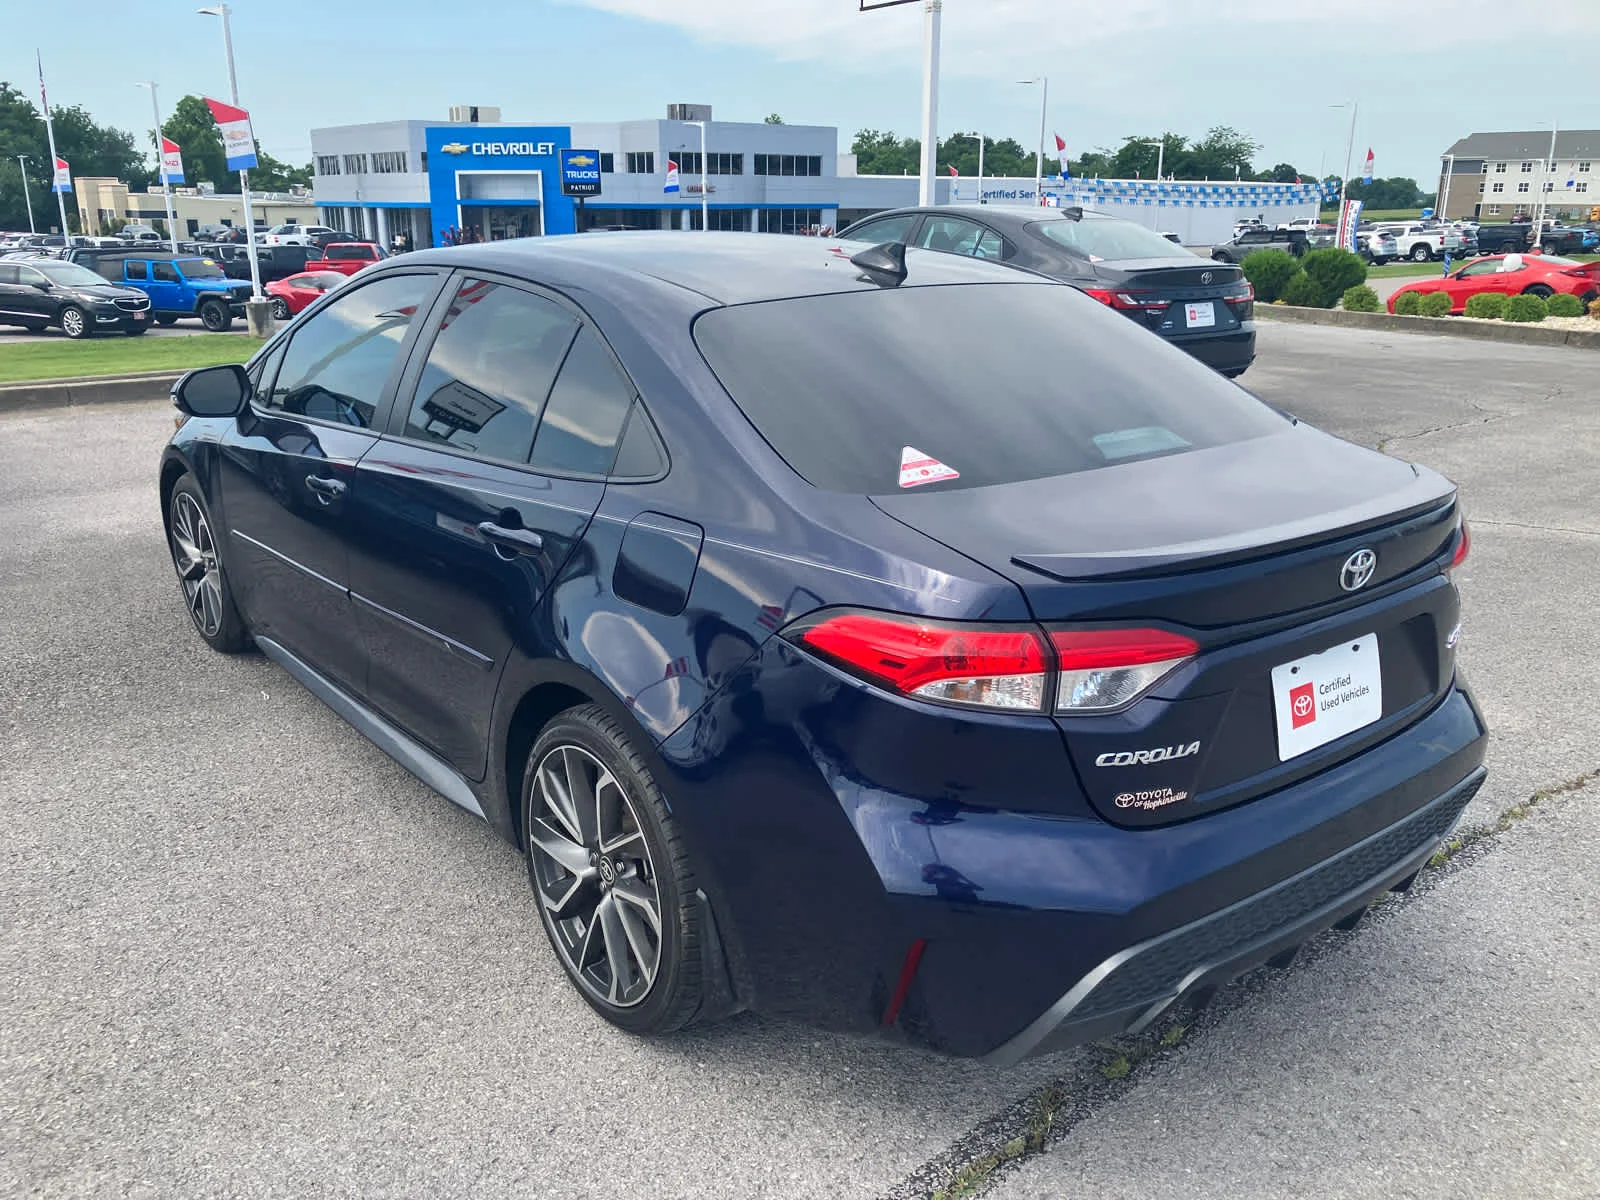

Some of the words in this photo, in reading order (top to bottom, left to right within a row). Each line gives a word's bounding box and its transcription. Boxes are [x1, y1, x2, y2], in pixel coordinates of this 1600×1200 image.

[472, 142, 555, 155] CHEVROLET
[566, 170, 599, 179] TRUCKS
[981, 189, 1016, 199] ertified
[1319, 674, 1351, 695] Certified
[1320, 693, 1339, 711] Used
[1341, 685, 1370, 703] Vehicles
[1095, 741, 1200, 767] COROLLA
[1134, 801, 1144, 809] OF
[1143, 792, 1188, 810] Hopkinsville
[1135, 788, 1173, 800] TOYOTA
